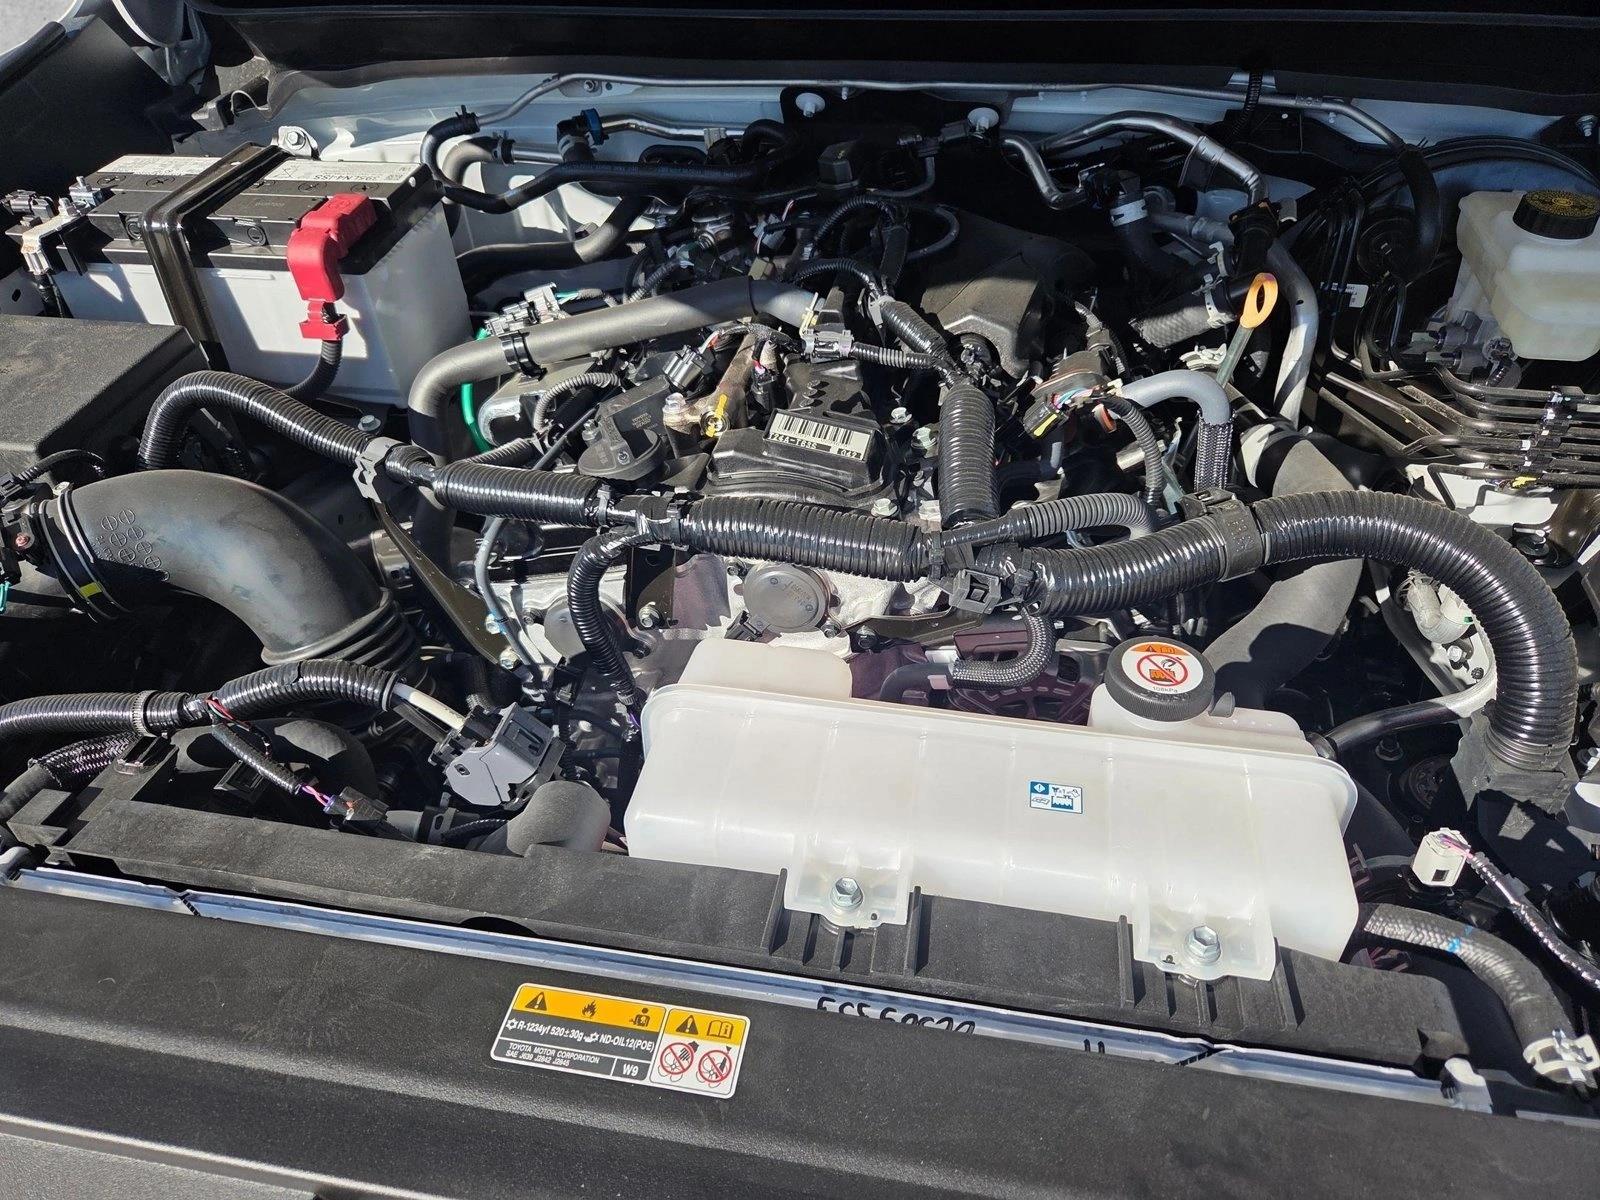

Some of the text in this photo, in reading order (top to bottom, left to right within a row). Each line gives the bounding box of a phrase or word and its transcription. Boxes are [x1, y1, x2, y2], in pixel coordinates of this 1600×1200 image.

[517, 1020, 551, 1035] R-1234yf
[505, 1050, 518, 1058] SAE
[509, 1042, 600, 1064] TOYOTA MOTOR CORPORATION
[622, 1063, 639, 1077] W9
